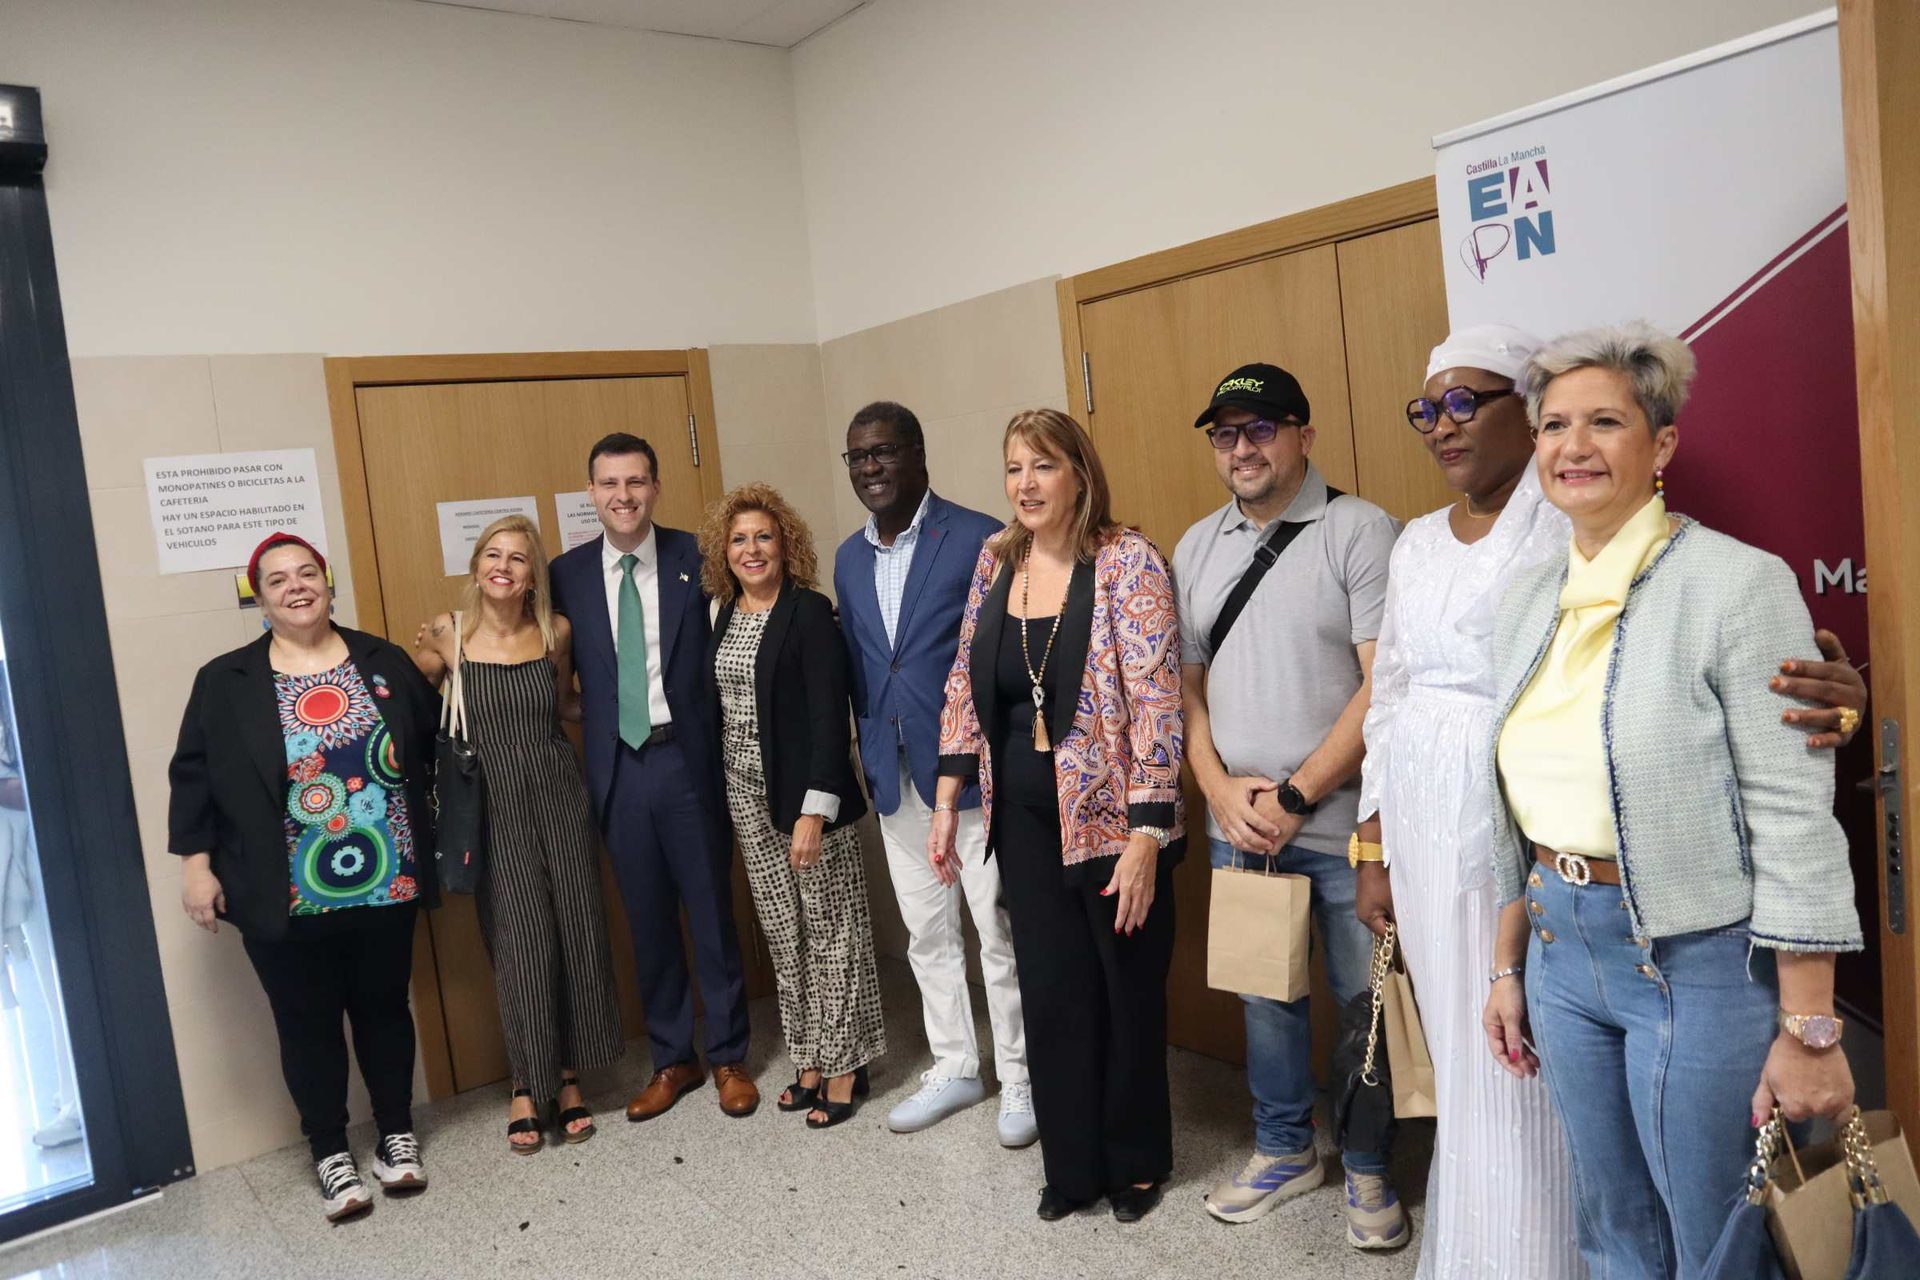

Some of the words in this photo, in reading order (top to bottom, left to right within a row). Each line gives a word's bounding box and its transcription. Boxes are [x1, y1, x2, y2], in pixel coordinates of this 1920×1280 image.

[1466, 159, 1498, 175] Castilla
[1498, 156, 1509, 166] La
[1511, 145, 1547, 161] Mancha
[156, 470, 179, 479] ESTA
[180, 467, 232, 478] PROHIBIDO
[233, 465, 262, 475] PASAR
[264, 463, 283, 472] CON
[158, 481, 227, 494] MONOPATINES
[228, 479, 236, 488] O
[237, 476, 285, 488] BICICLETAS
[286, 476, 293, 484] A
[294, 475, 306, 484] LA
[160, 496, 209, 507] CAFETERIA
[162, 513, 182, 522] HAY
[183, 512, 198, 521] UN
[200, 508, 237, 519] ESPACIO
[239, 504, 292, 516] HABILITADO
[293, 503, 305, 512] EN
[164, 528, 174, 536] EL
[176, 524, 215, 535] SOTANO
[217, 522, 241, 532] PARA
[243, 520, 263, 529] ESTE
[265, 518, 285, 528] TIPO
[286, 517, 298, 526] DE
[166, 538, 217, 550] VEHICULOS
